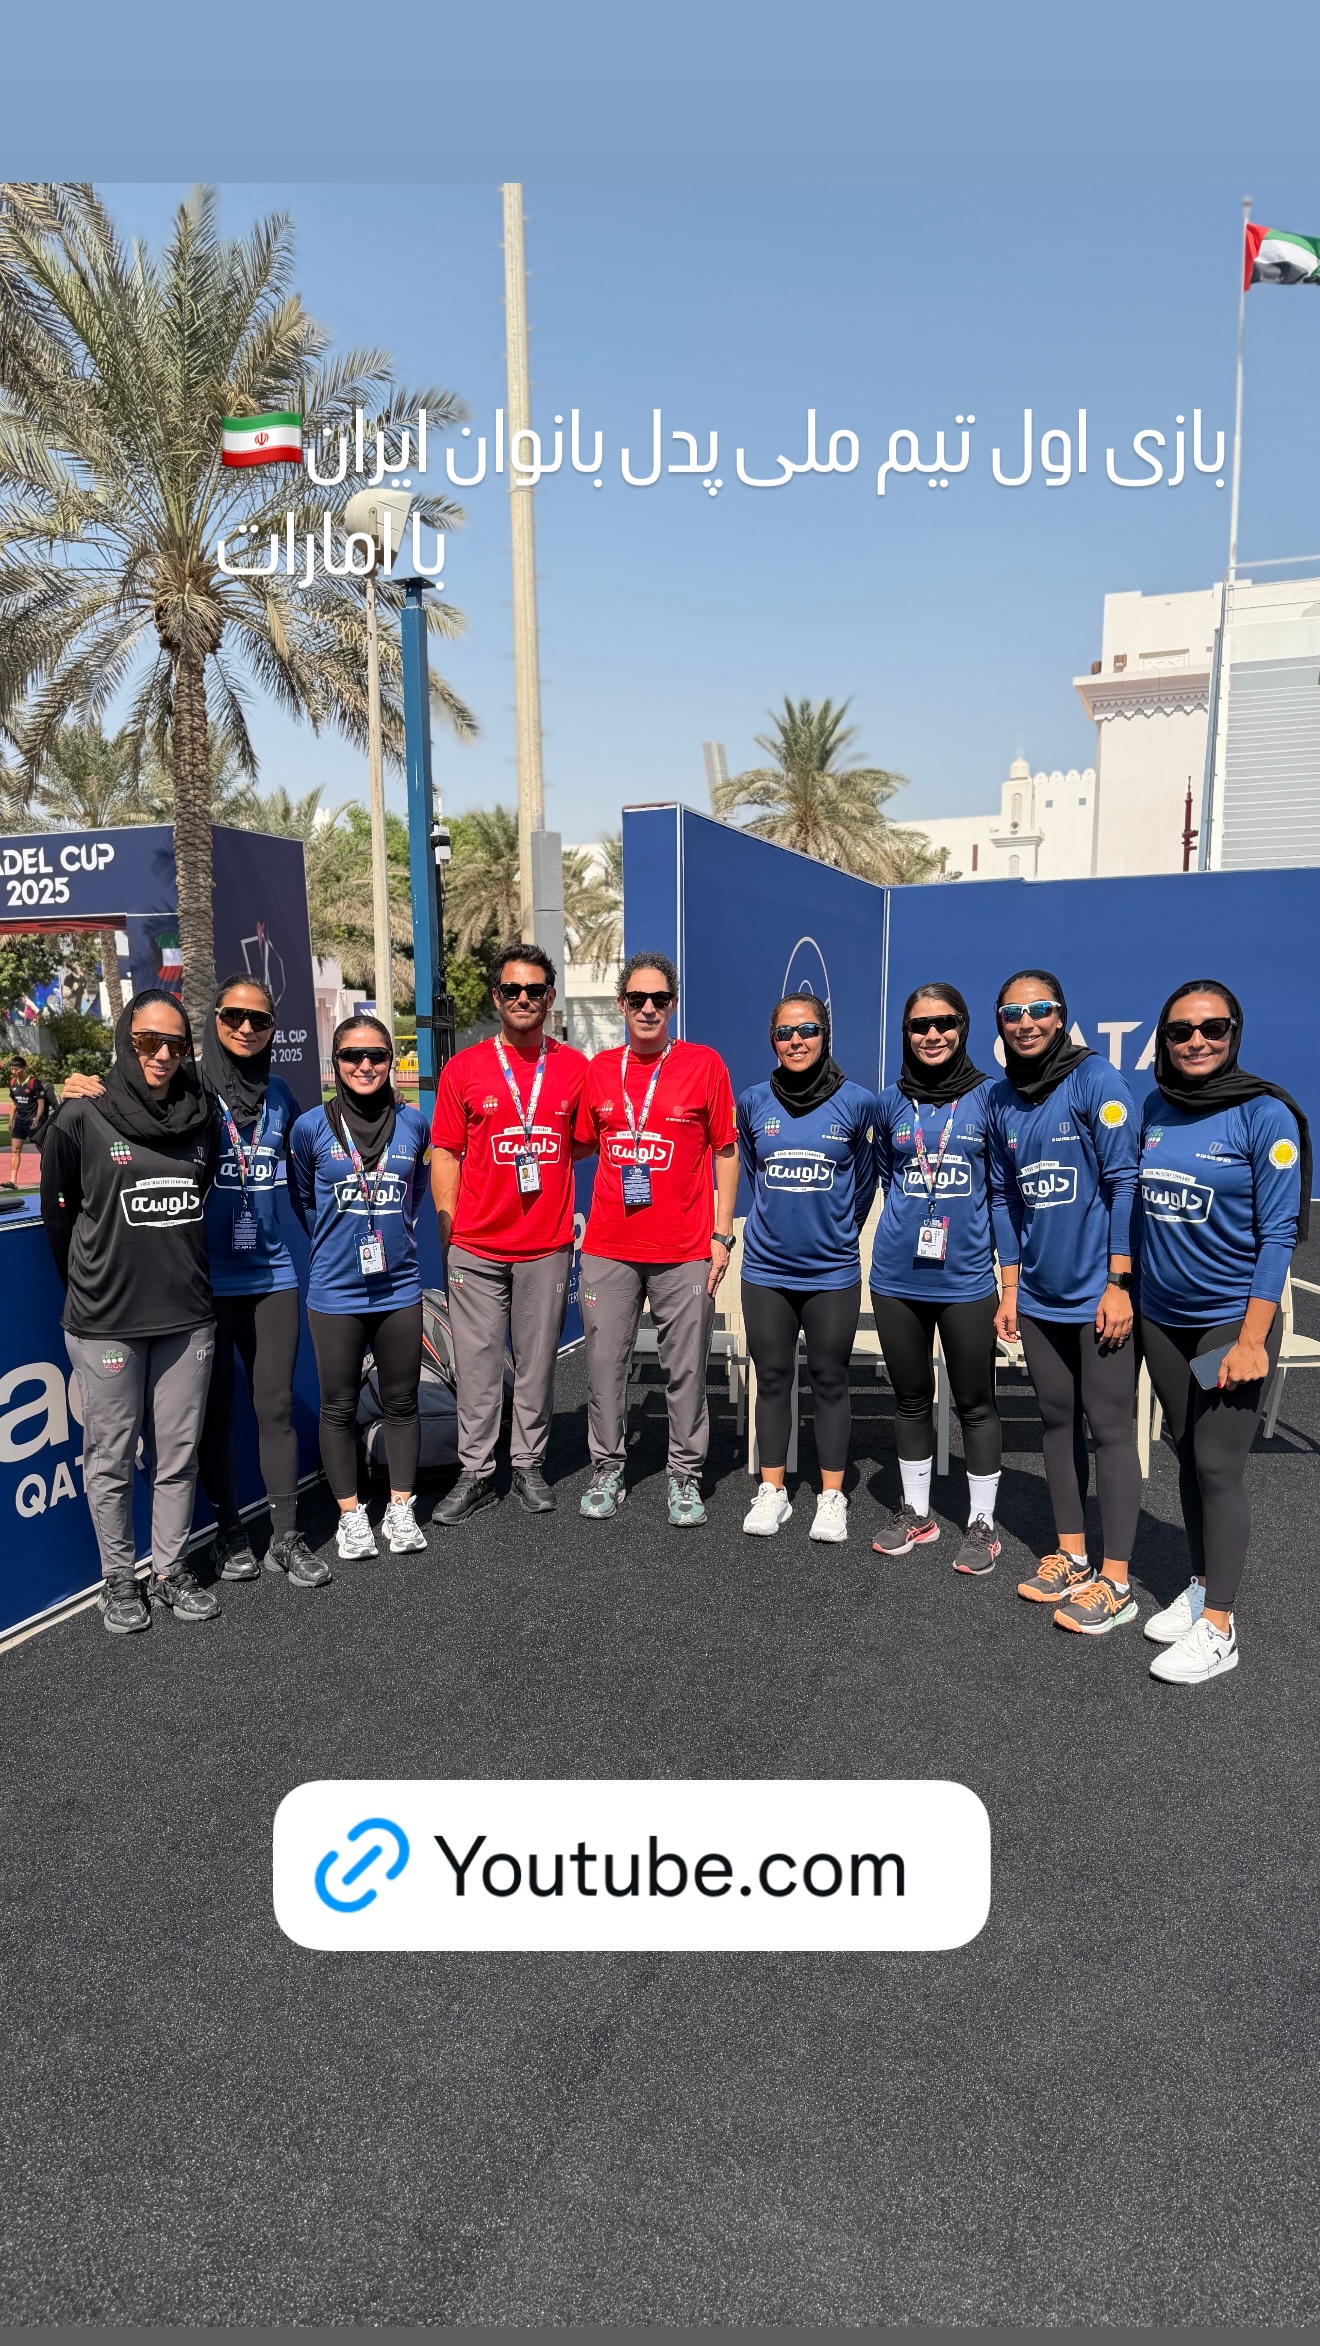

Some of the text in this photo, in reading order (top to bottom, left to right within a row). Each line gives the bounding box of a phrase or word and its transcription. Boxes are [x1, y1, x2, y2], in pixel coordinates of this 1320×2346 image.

[0, 843, 115, 876] DEL CUP
[6, 877, 70, 906] 2025
[289, 1029, 307, 1043] CUP
[278, 1048, 303, 1062] 2025
[768, 1163, 830, 1183] دلوسه
[131, 1191, 200, 1215] دلوسه
